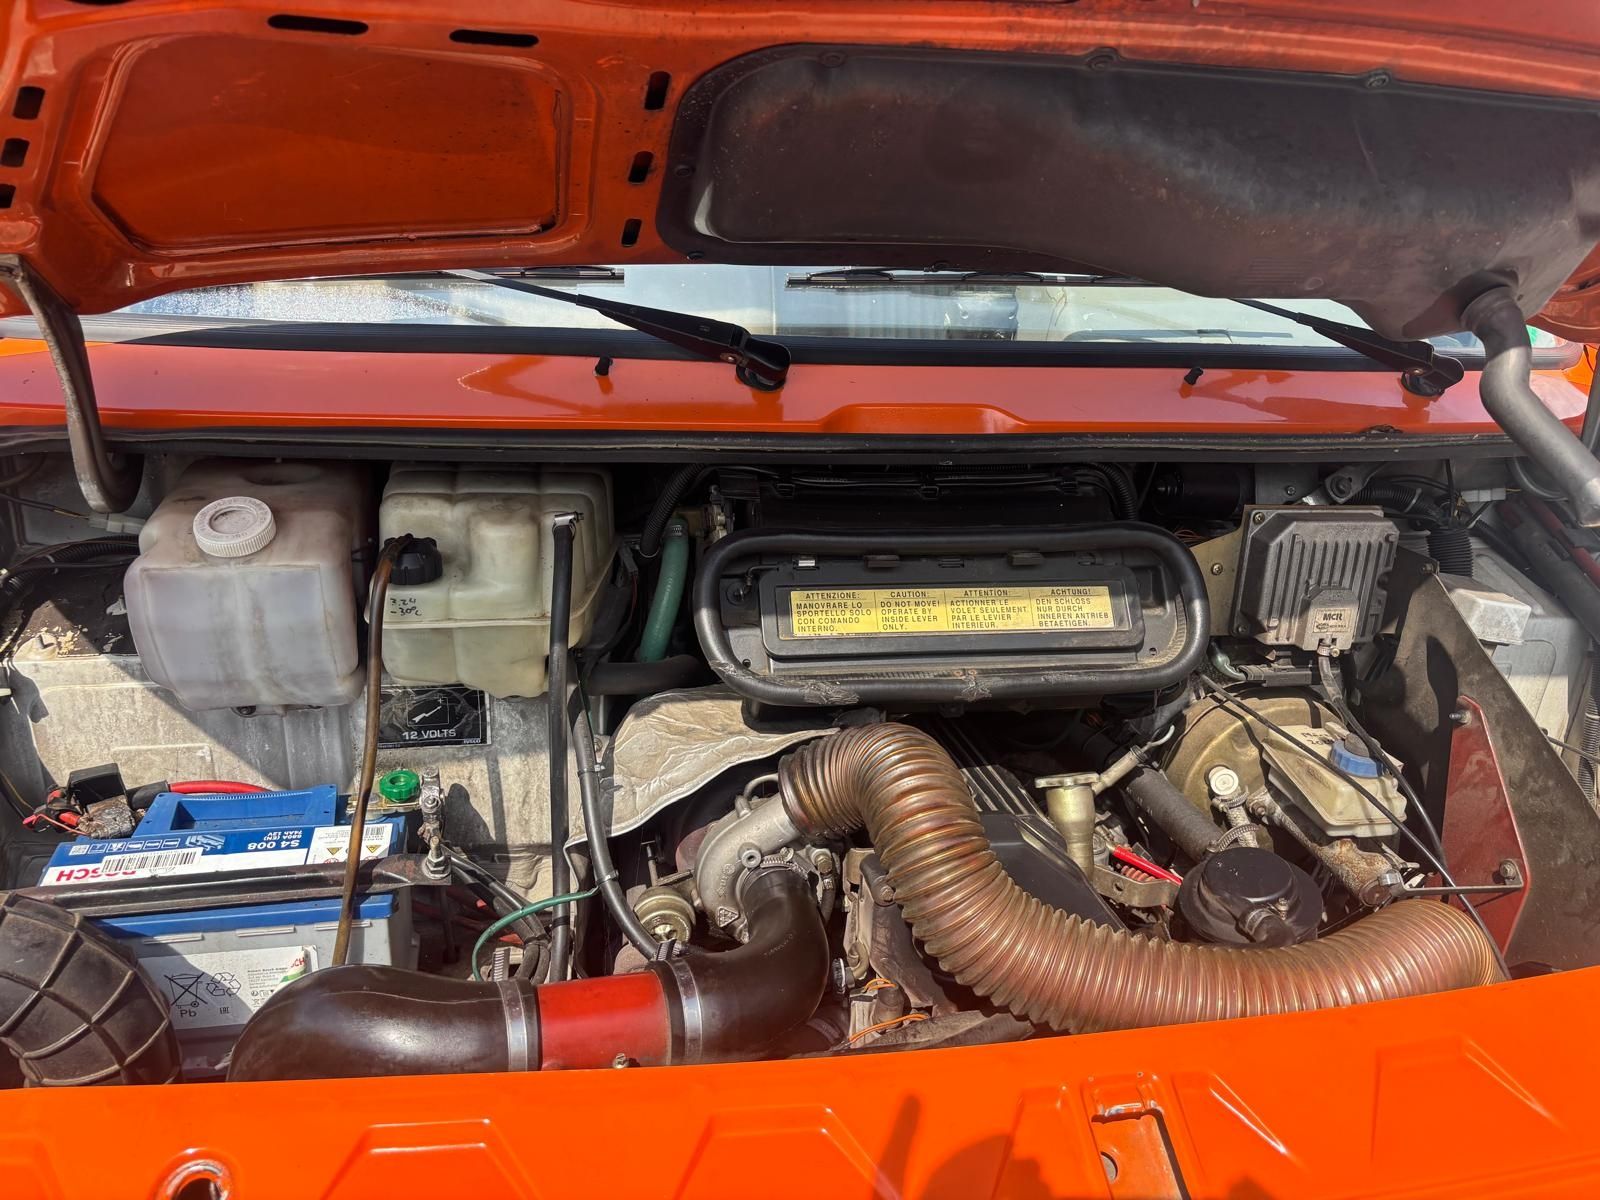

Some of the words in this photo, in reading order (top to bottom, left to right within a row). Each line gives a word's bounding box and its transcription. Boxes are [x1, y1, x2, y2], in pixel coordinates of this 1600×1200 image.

[805, 592, 861, 600] ATTENZIONE:
[796, 602, 848, 610] MANOVRARE
[851, 601, 863, 609] LO
[894, 600, 911, 608] NOT
[914, 600, 940, 608] MOVE!
[1054, 597, 1091, 605] SCHLOSS
[796, 609, 846, 617] SPORTELLO
[881, 608, 919, 616] OPERATE
[921, 607, 932, 615] BY
[979, 606, 1027, 614] SEULEMENT
[983, 613, 1012, 621] LEVIER
[1075, 611, 1109, 619] ANTRIEB
[1322, 612, 1343, 621] MCR
[797, 617, 815, 625] CON
[818, 616, 860, 624] COMANDO
[797, 624, 838, 633] INTERNO.
[882, 623, 908, 631] ONLY.
[402, 731, 418, 740] 12
[421, 728, 457, 739] VOLTS
[247, 841, 277, 850] 008
[280, 839, 301, 848] S4
[180, 1009, 197, 1018] Pb
